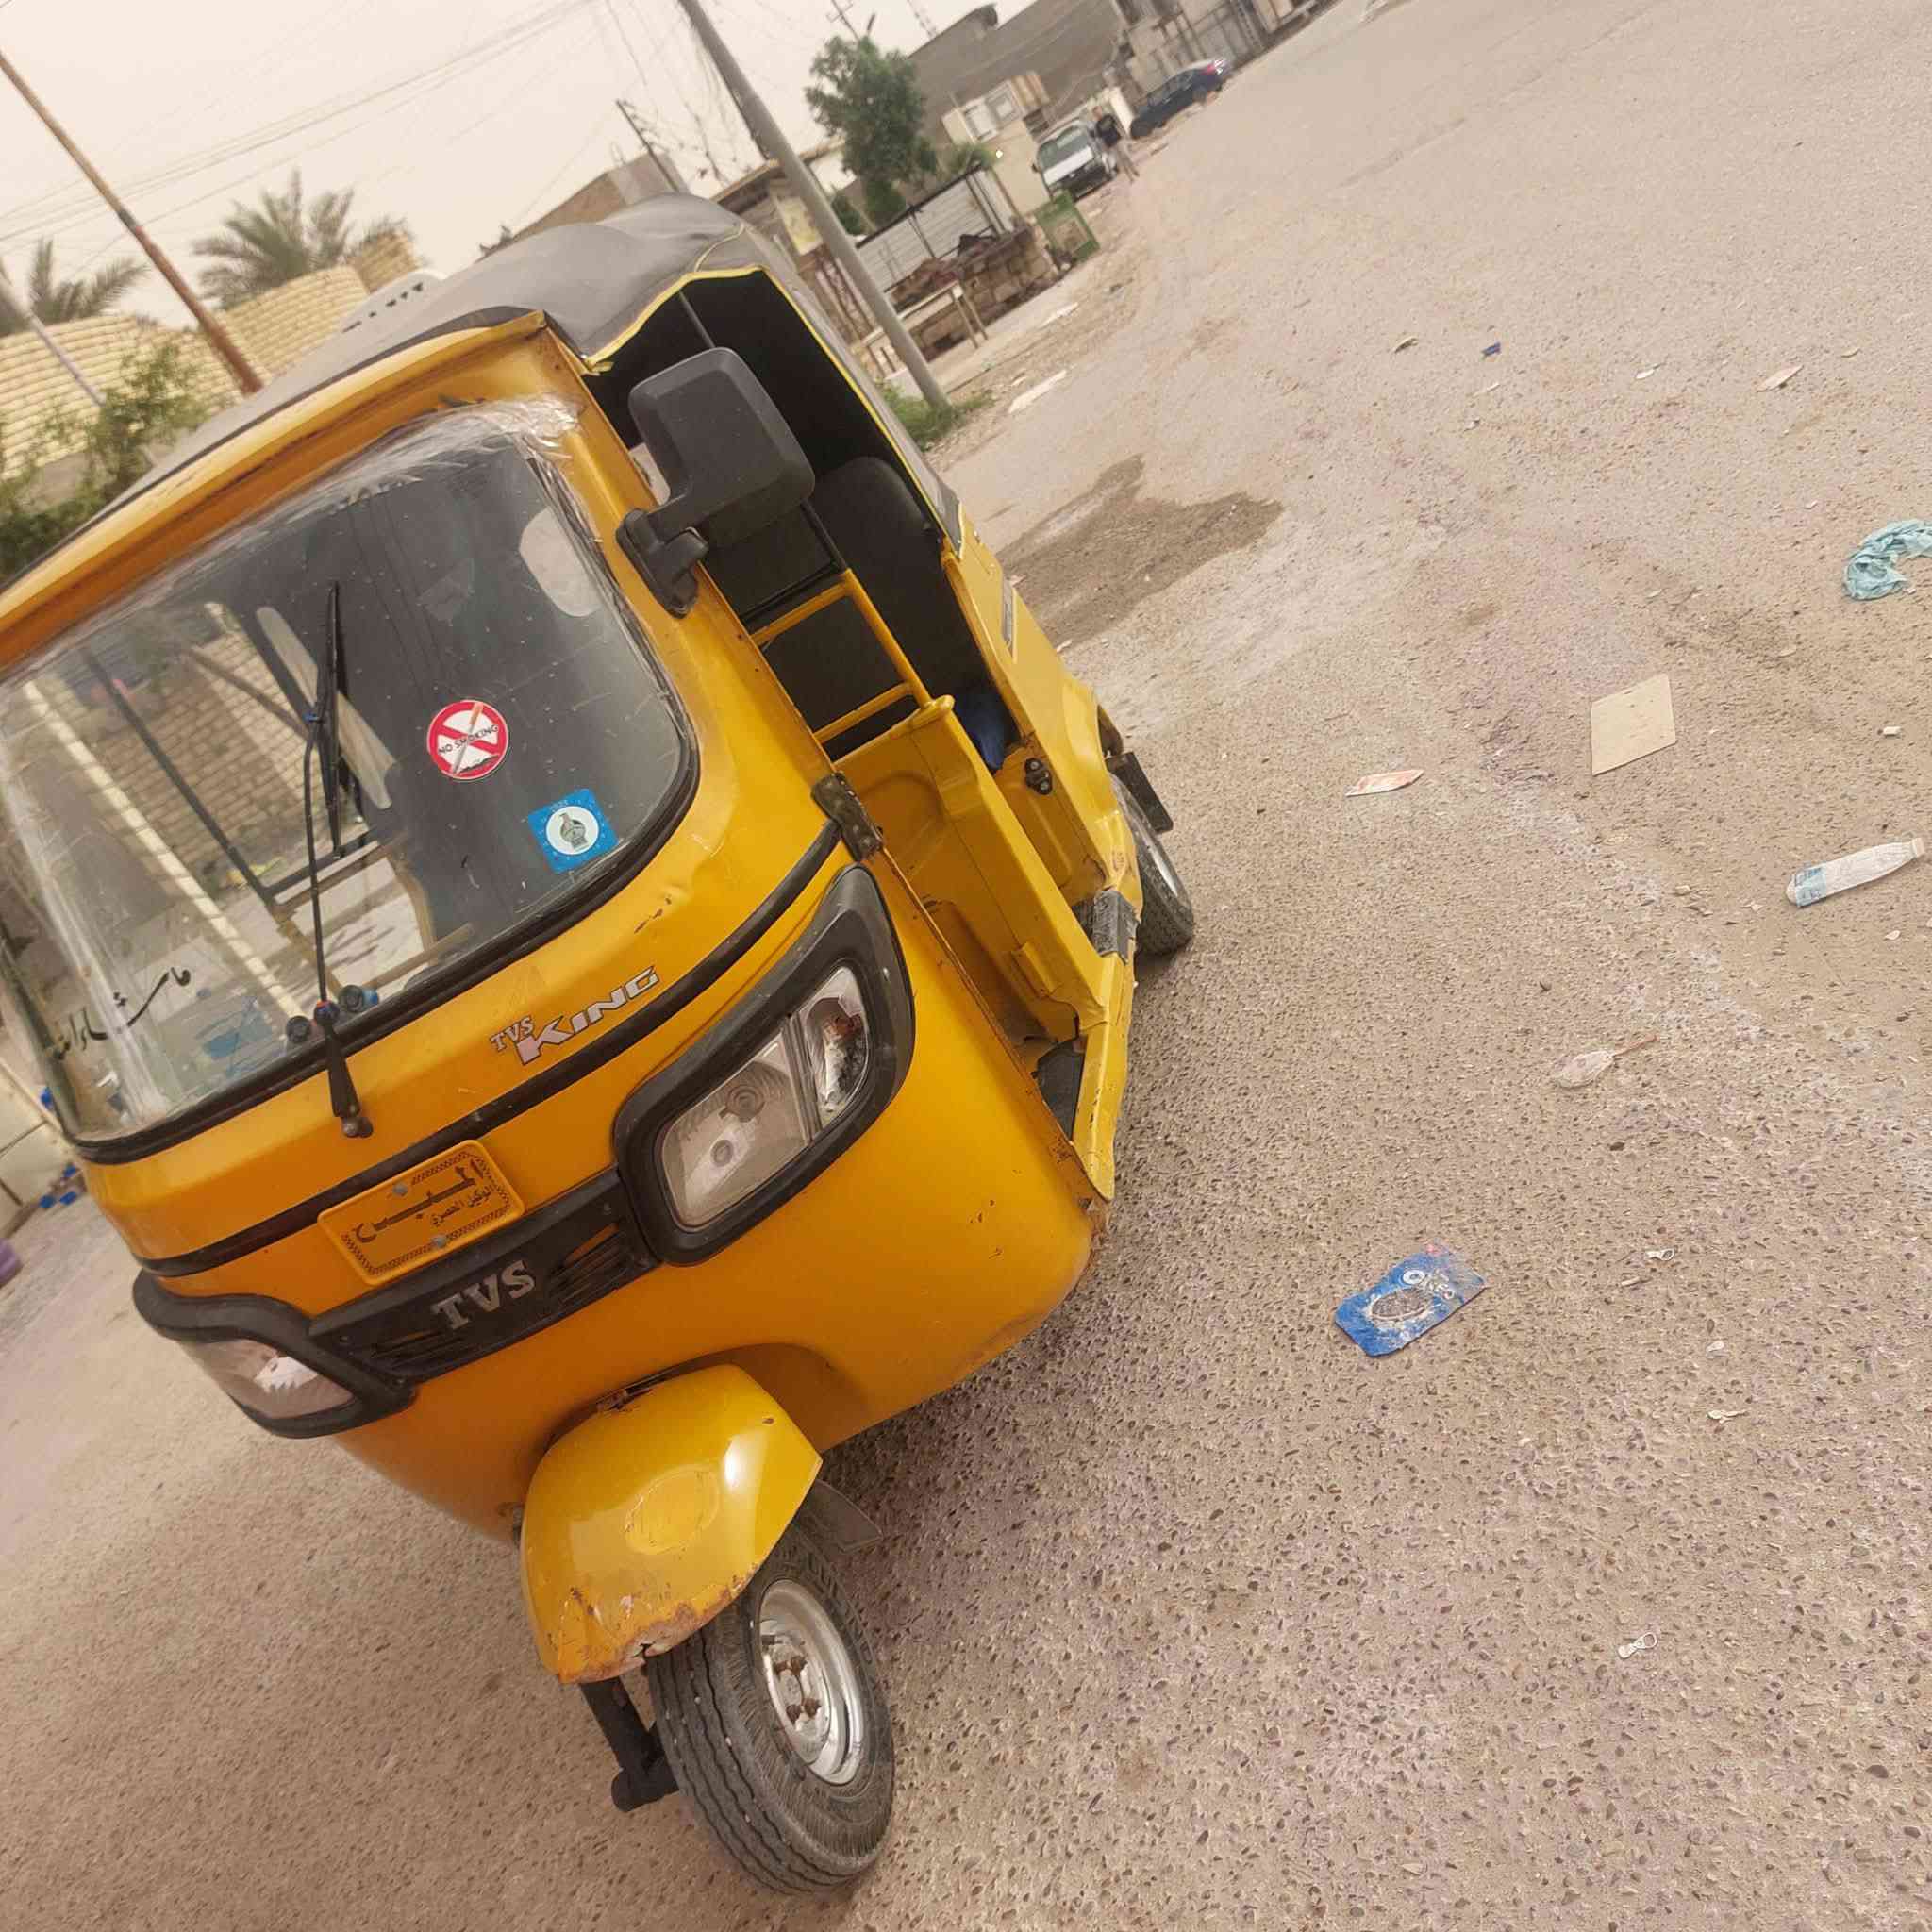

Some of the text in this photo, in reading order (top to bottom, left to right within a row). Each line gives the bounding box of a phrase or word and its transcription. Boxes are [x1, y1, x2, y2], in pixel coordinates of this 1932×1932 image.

[438, 724, 499, 755] NO SMOKING
[489, 1015, 535, 1053] TVS
[515, 965, 660, 1066] KING
[431, 1259, 536, 1329] TVS
